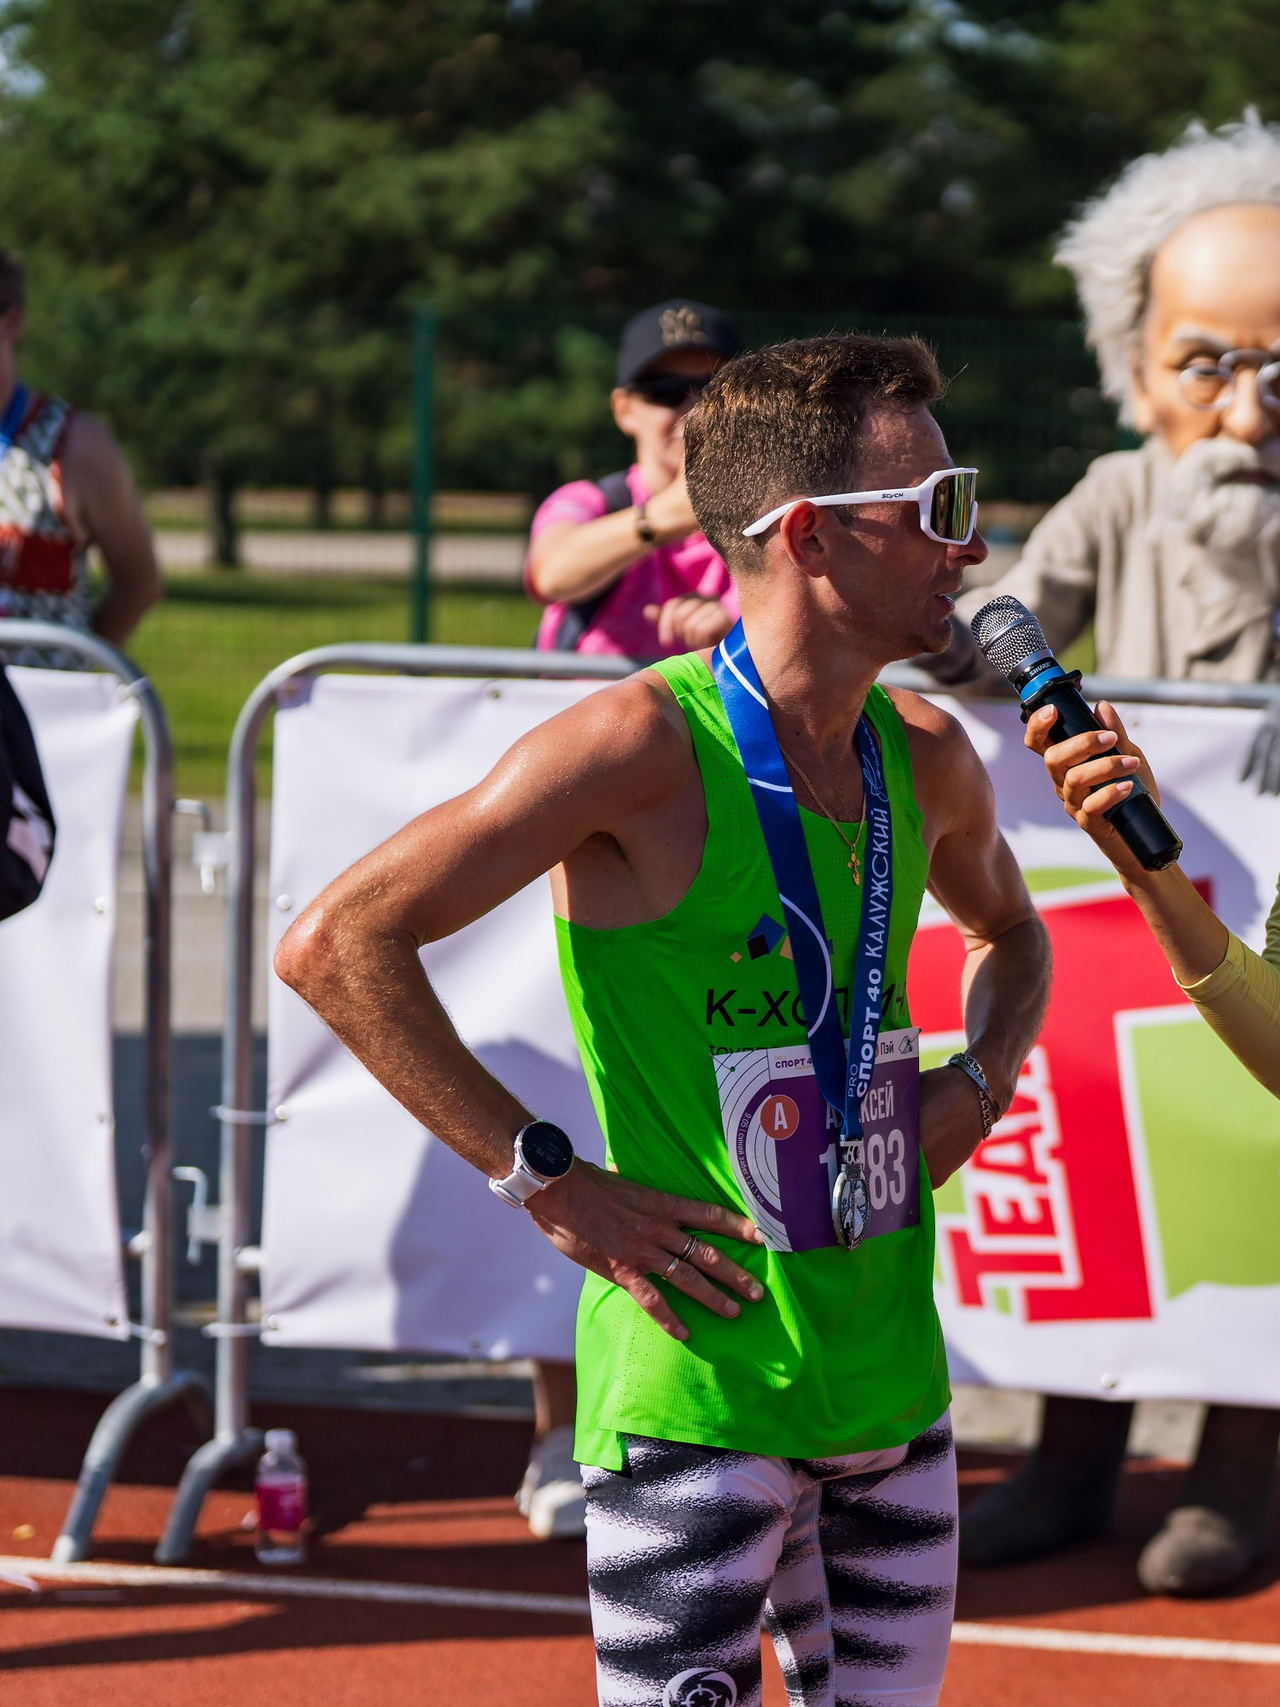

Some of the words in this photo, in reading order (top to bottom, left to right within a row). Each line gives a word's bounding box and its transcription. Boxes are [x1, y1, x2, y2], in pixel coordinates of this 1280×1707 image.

[1029, 661, 1052, 677] SHURE
[865, 808, 890, 958] КАЛУЖСКИЙ
[867, 968, 883, 1003] 40
[775, 1058, 805, 1069] СПОРТ
[857, 1007, 880, 1098] СПОРТ
[848, 1063, 859, 1099] PRO
[826, 1080, 894, 1130] АКСЕЙ
[819, 1129, 905, 1216] 183
